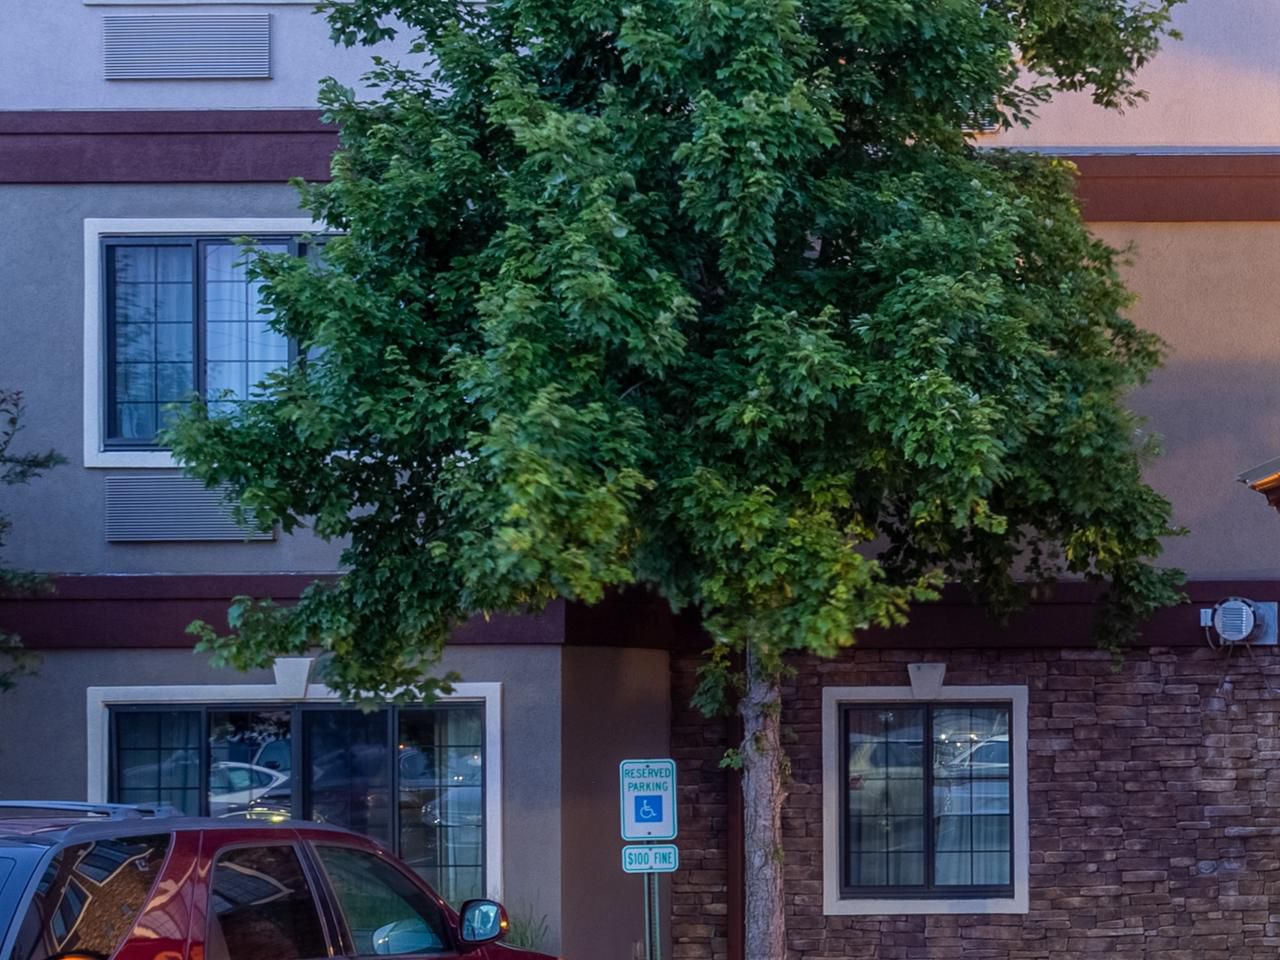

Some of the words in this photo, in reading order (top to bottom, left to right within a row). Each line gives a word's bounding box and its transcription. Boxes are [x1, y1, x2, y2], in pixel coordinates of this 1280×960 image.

[624, 768, 671, 779] RESERVED
[627, 781, 669, 792] PARKING
[627, 852, 650, 866] $100
[654, 851, 673, 865] FINE
